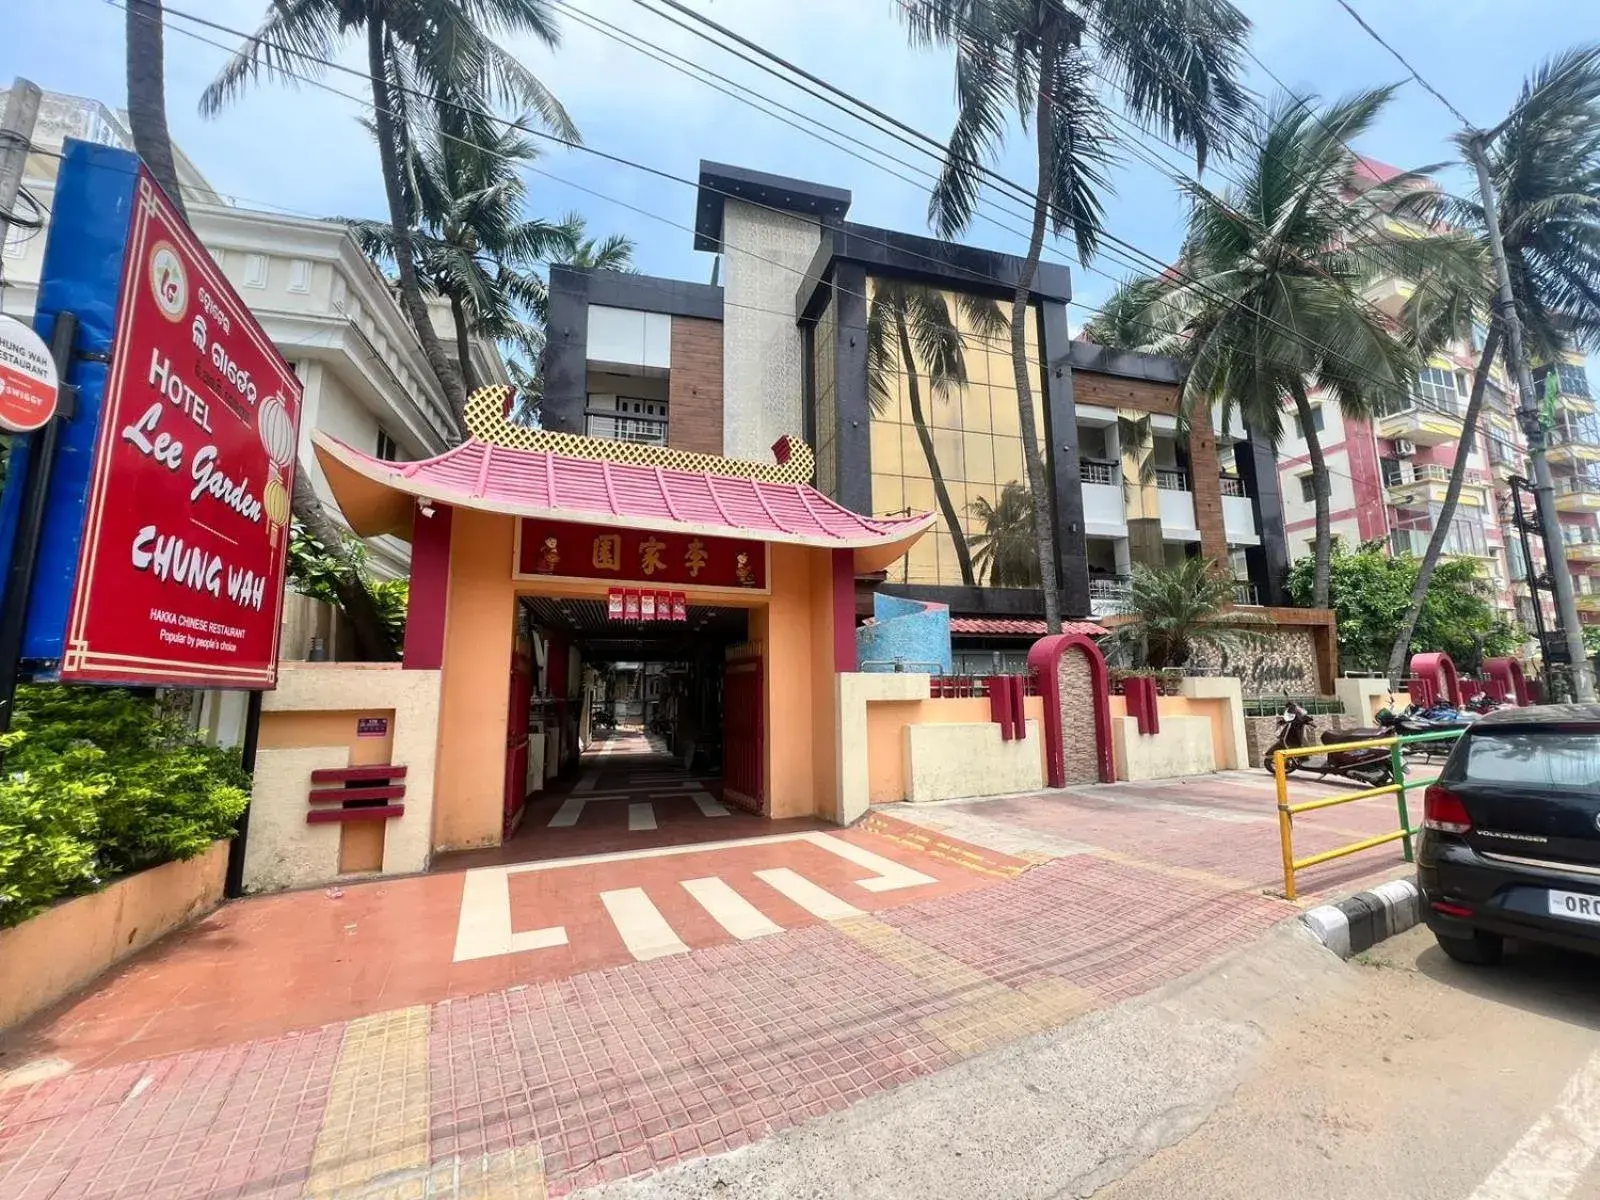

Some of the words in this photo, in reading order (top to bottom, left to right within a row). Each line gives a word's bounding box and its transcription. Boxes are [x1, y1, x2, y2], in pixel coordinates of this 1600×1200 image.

[28, 350, 47, 367] WAH
[5, 386, 42, 406] SWIGGY
[148, 347, 213, 433] HOTEL
[122, 402, 183, 469] Lee
[191, 445, 261, 522] Garden
[132, 525, 222, 598] CHUNG
[228, 564, 266, 612] WAH
[149, 608, 177, 625] HAKKA
[178, 614, 209, 632] CHINESE
[208, 622, 246, 639] RESTAURANT
[160, 628, 186, 645] Popular
[187, 634, 195, 648] by
[195, 638, 220, 650] people's
[220, 641, 237, 653] choice
[1476, 829, 1548, 843] VOLKSWAGEN
